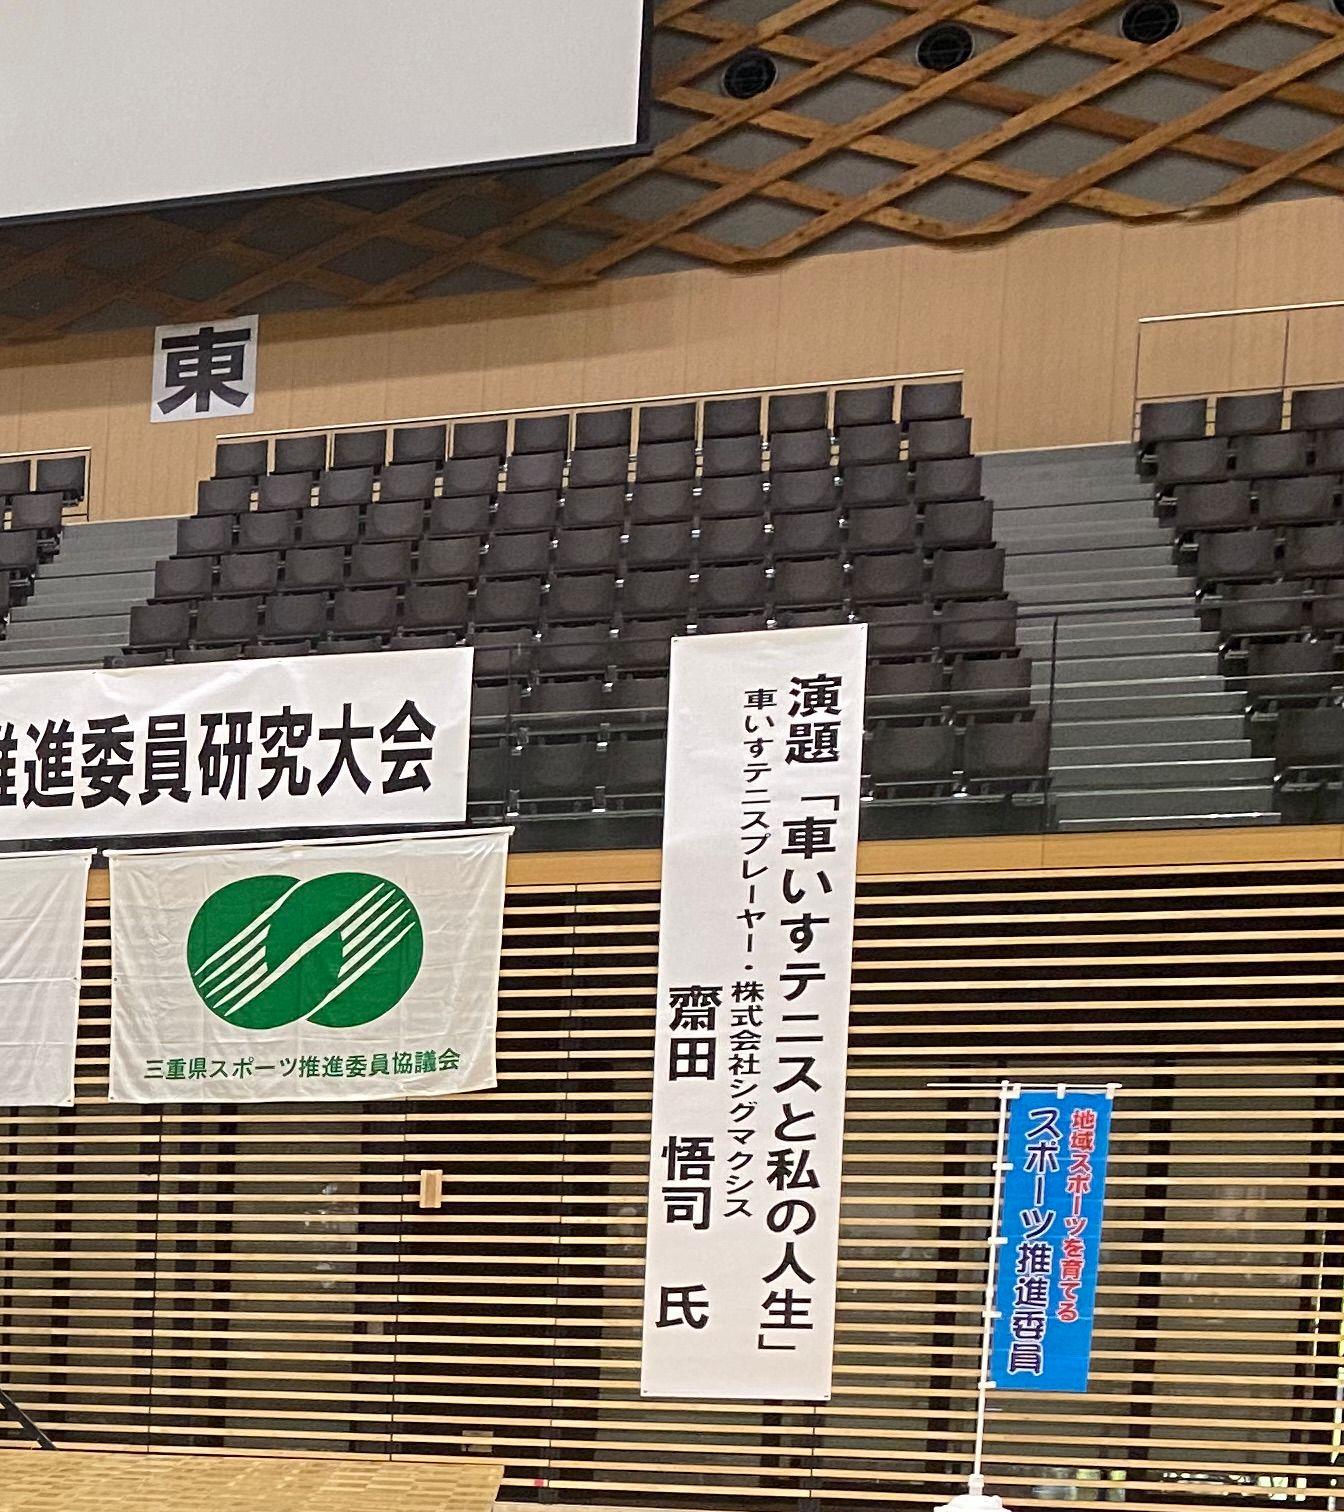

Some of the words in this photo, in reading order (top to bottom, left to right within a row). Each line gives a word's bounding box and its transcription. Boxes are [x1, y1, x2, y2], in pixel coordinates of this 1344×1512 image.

[157, 327, 251, 414] 東
[144, 1048, 460, 1080] 三重県スポーツ推進委員協議会
[1007, 1106, 1060, 1375] スポーツ推進委員
[1057, 1108, 1096, 1322] 地域スポーツを育てる
[655, 1284, 710, 1329] 氏
